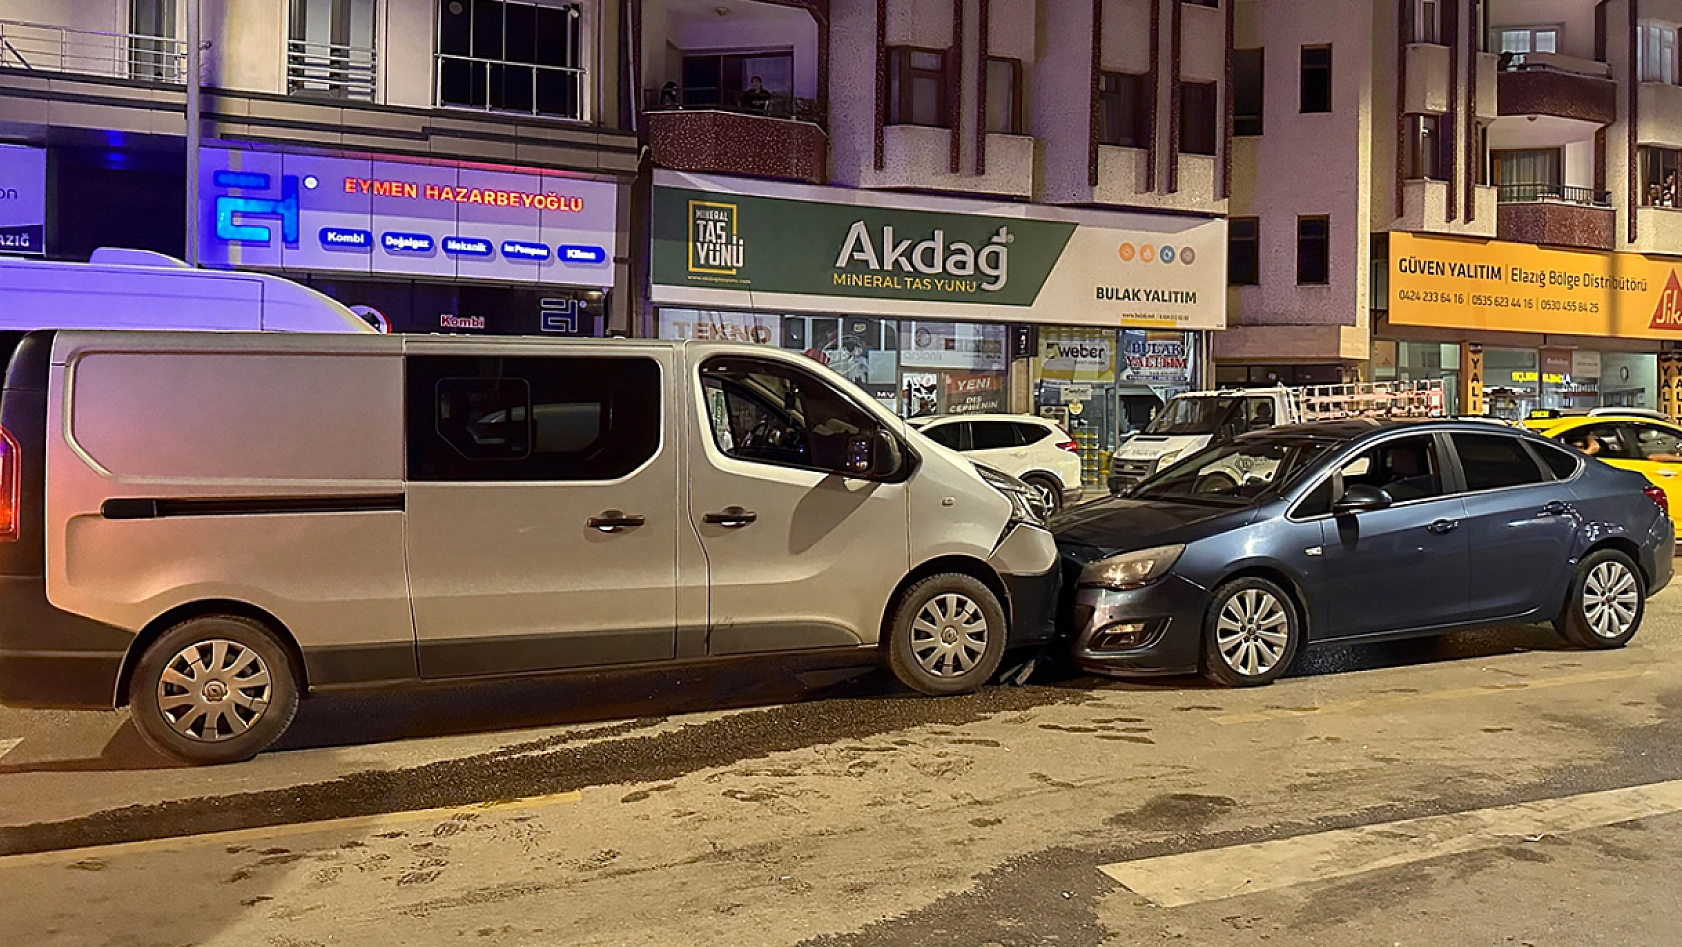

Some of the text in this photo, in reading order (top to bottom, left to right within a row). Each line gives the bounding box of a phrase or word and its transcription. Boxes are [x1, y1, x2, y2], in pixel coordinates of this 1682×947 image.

[344, 178, 583, 212] EYMEN HAZARBEYOĞLU
[327, 231, 365, 244] Kombi
[696, 235, 744, 268] YÜNÜ
[835, 220, 1008, 292] Akdağ
[1399, 255, 1647, 292] GÜVEN YALITIM Elazığ Bölge Distribütörü
[1096, 286, 1197, 304] BULAK YALITIM
[1399, 289, 1421, 301] 0424
[1422, 290, 1439, 302] 233
[1440, 293, 1451, 303] 64
[1454, 293, 1464, 305] 16
[1472, 294, 1493, 306] 0535
[1494, 296, 1509, 307] 623
[1511, 297, 1521, 308] 44
[1541, 299, 1560, 311] 0530
[440, 314, 485, 329] Kombi
[1059, 344, 1105, 359] weber
[1126, 355, 1187, 370] YALITIM
